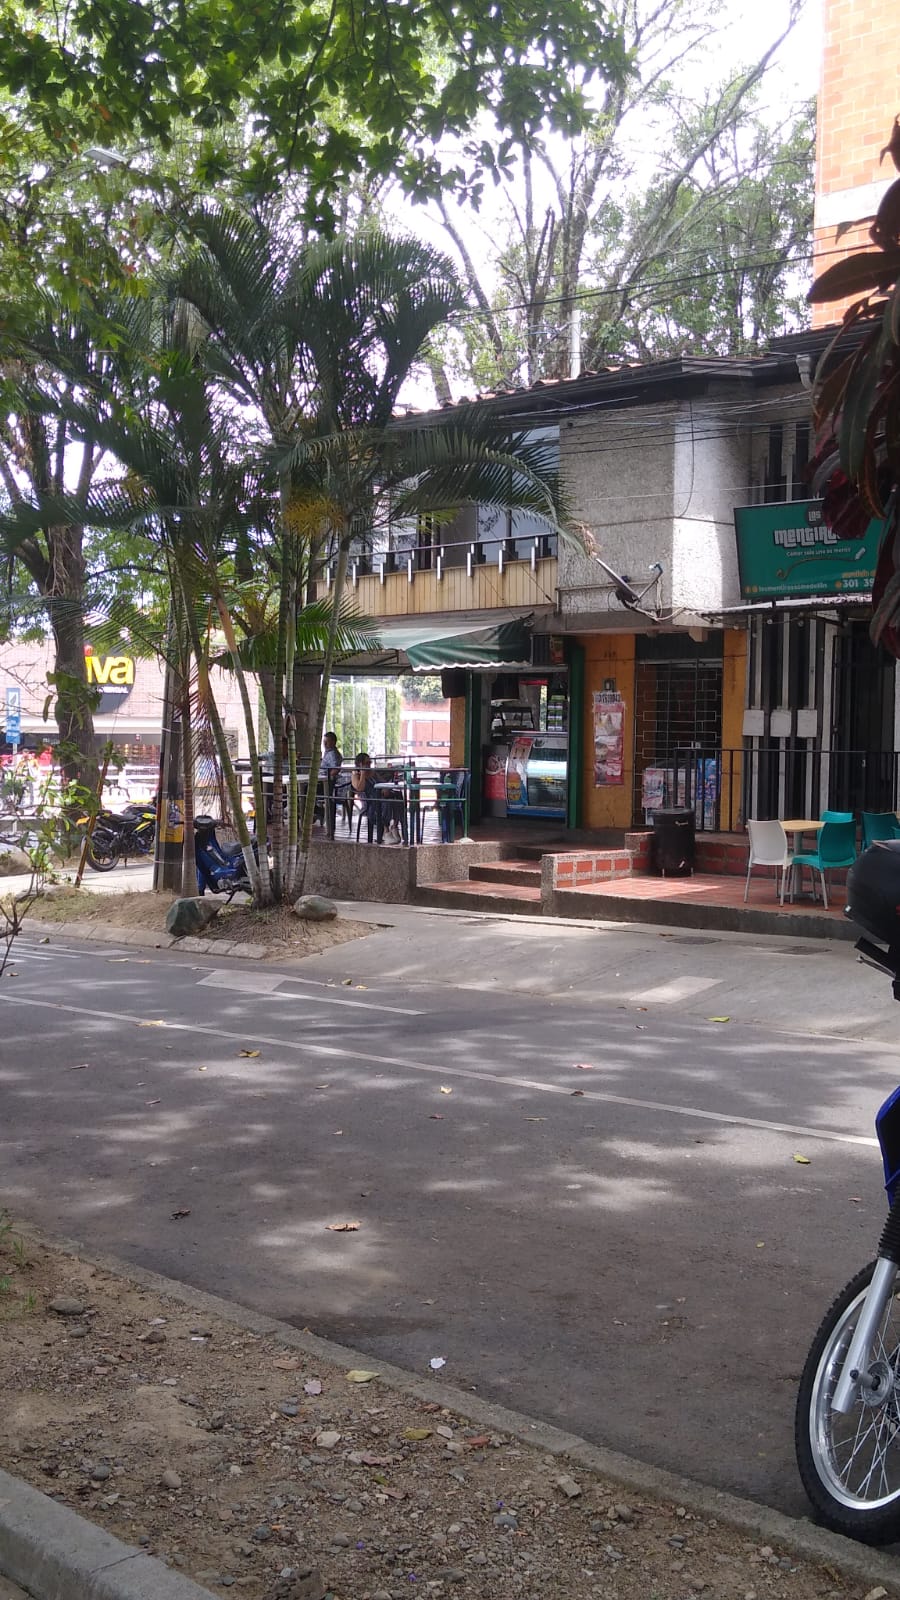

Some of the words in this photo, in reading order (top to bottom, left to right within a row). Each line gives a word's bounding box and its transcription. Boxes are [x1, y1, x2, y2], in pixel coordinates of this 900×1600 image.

[842, 579, 859, 588] 301
[863, 578, 875, 587] 39
[84, 644, 134, 685] iva
